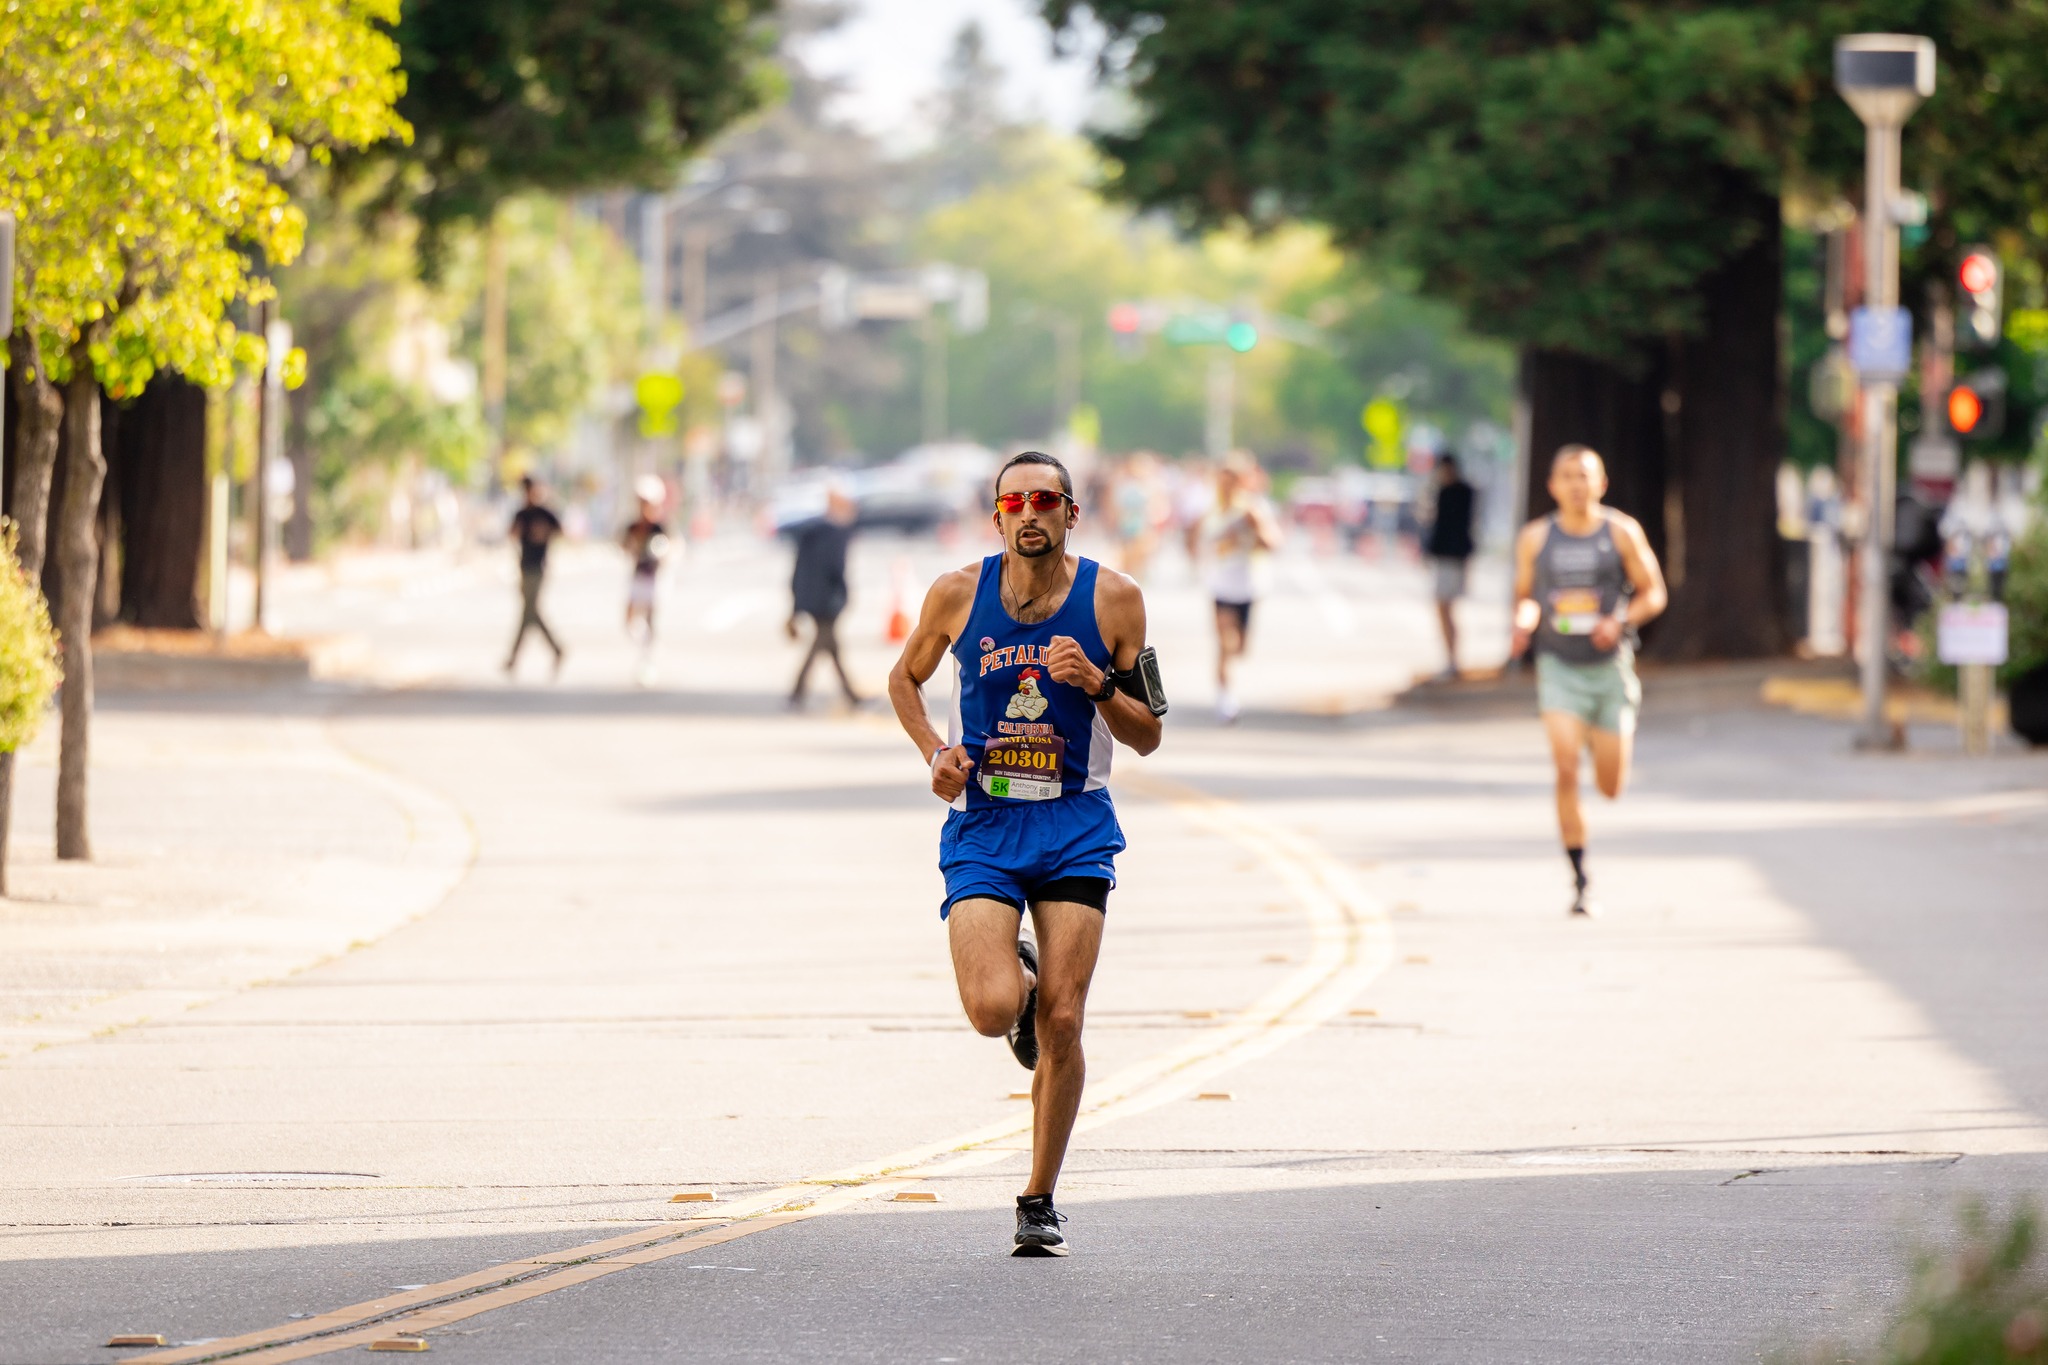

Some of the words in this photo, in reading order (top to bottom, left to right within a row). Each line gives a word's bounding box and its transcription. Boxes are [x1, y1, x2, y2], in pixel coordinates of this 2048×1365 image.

[979, 644, 1050, 677] PETALU
[997, 721, 1054, 734] CALIFORNIA
[1028, 736, 1052, 744] ROSA
[988, 750, 1057, 770] 20301
[992, 781, 1009, 793] 5K
[1011, 781, 1038, 791] Anthony
